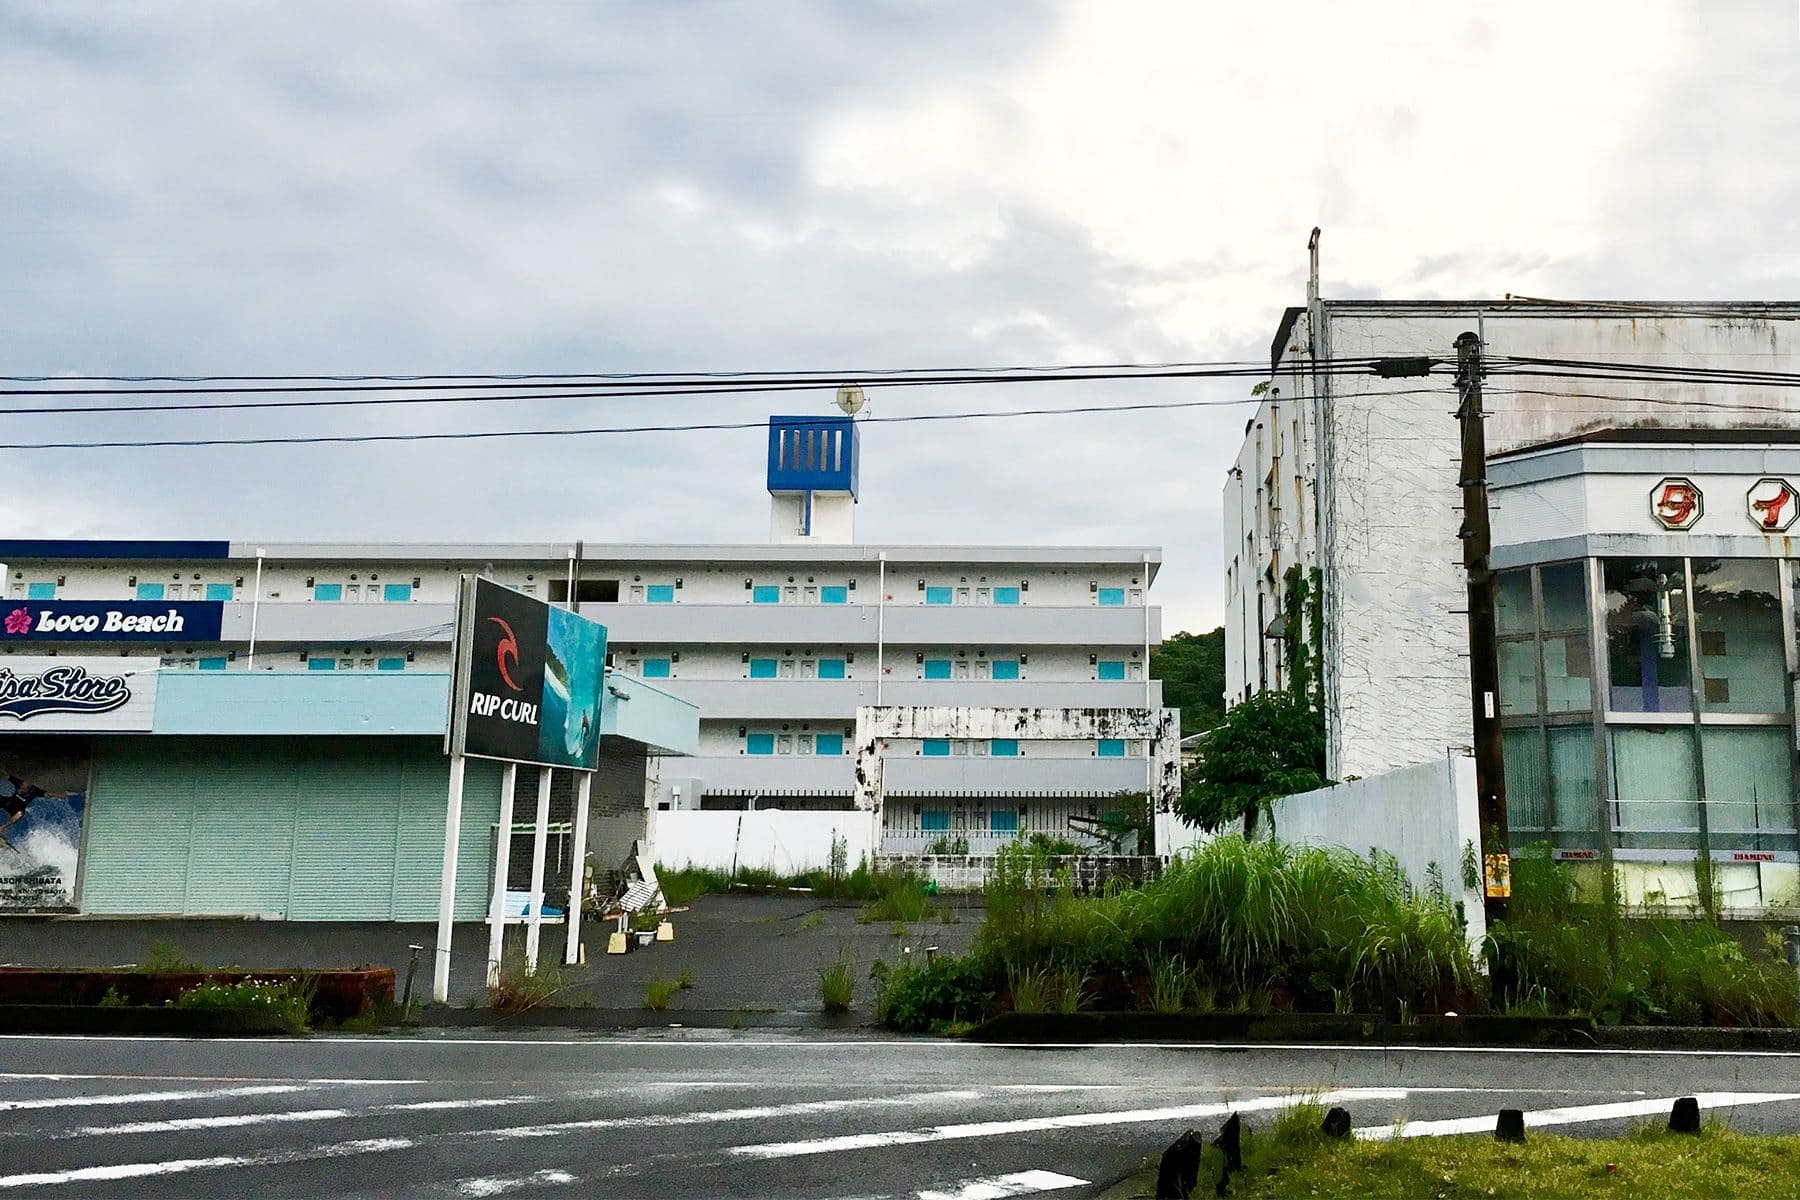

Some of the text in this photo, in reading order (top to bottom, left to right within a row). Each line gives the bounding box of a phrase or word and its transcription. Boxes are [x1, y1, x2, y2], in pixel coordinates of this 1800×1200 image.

[35, 609, 184, 632] Loco Beach
[41, 666, 125, 699] Store
[470, 692, 538, 725] RIP CURL
[1733, 853, 1775, 861] DIAMOND
